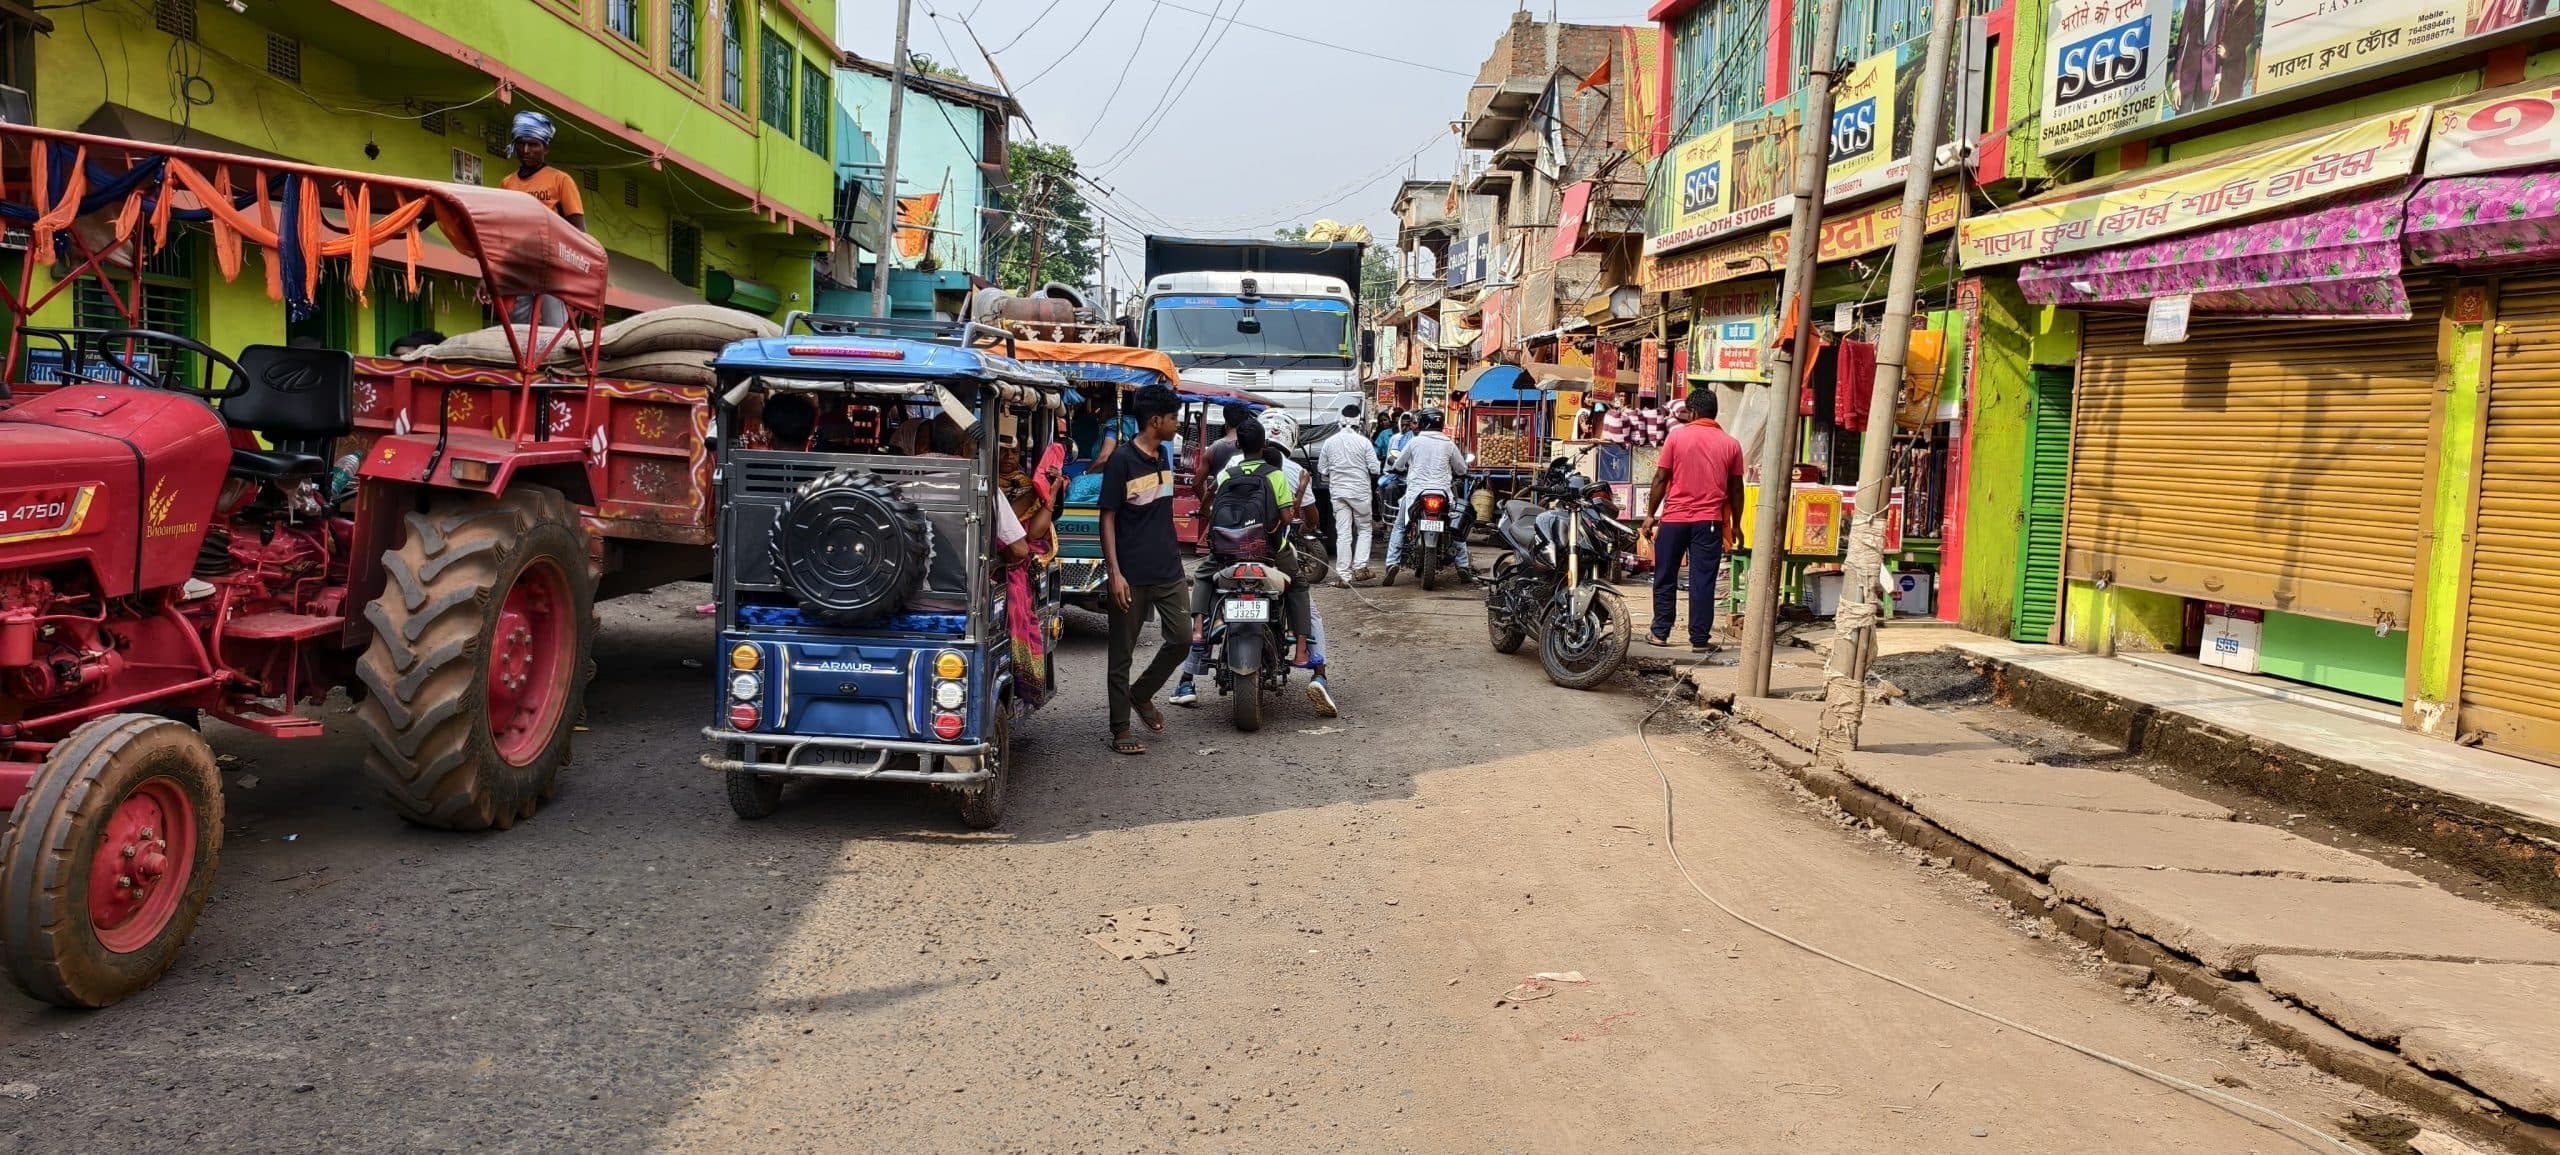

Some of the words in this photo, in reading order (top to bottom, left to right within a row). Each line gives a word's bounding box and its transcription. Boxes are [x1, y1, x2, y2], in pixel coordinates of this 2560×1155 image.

[2060, 26, 2144, 98] SGS
[2267, 52, 2313, 78] শারদা
[2319, 41, 2351, 71] ক্লথ
[2356, 27, 2401, 55] ষ্টোর
[2042, 118, 2085, 141] SHARADA
[2087, 107, 2120, 128] CLOTH
[2121, 95, 2156, 117] STORE
[1685, 166, 1720, 209] SGS
[1971, 229, 2035, 256] শারদা
[2040, 219, 2091, 254] ক্লথ
[2181, 178, 2259, 216] শাড়ি
[2266, 146, 2384, 198] হাউস
[1656, 229, 1694, 249] SHARDA
[1696, 217, 1732, 237] CLOTH
[1736, 202, 1776, 226] STORE
[12, 502, 65, 521] 475DI
[820, 661, 873, 671] ARMUR
[2217, 638, 2239, 654] SGS
